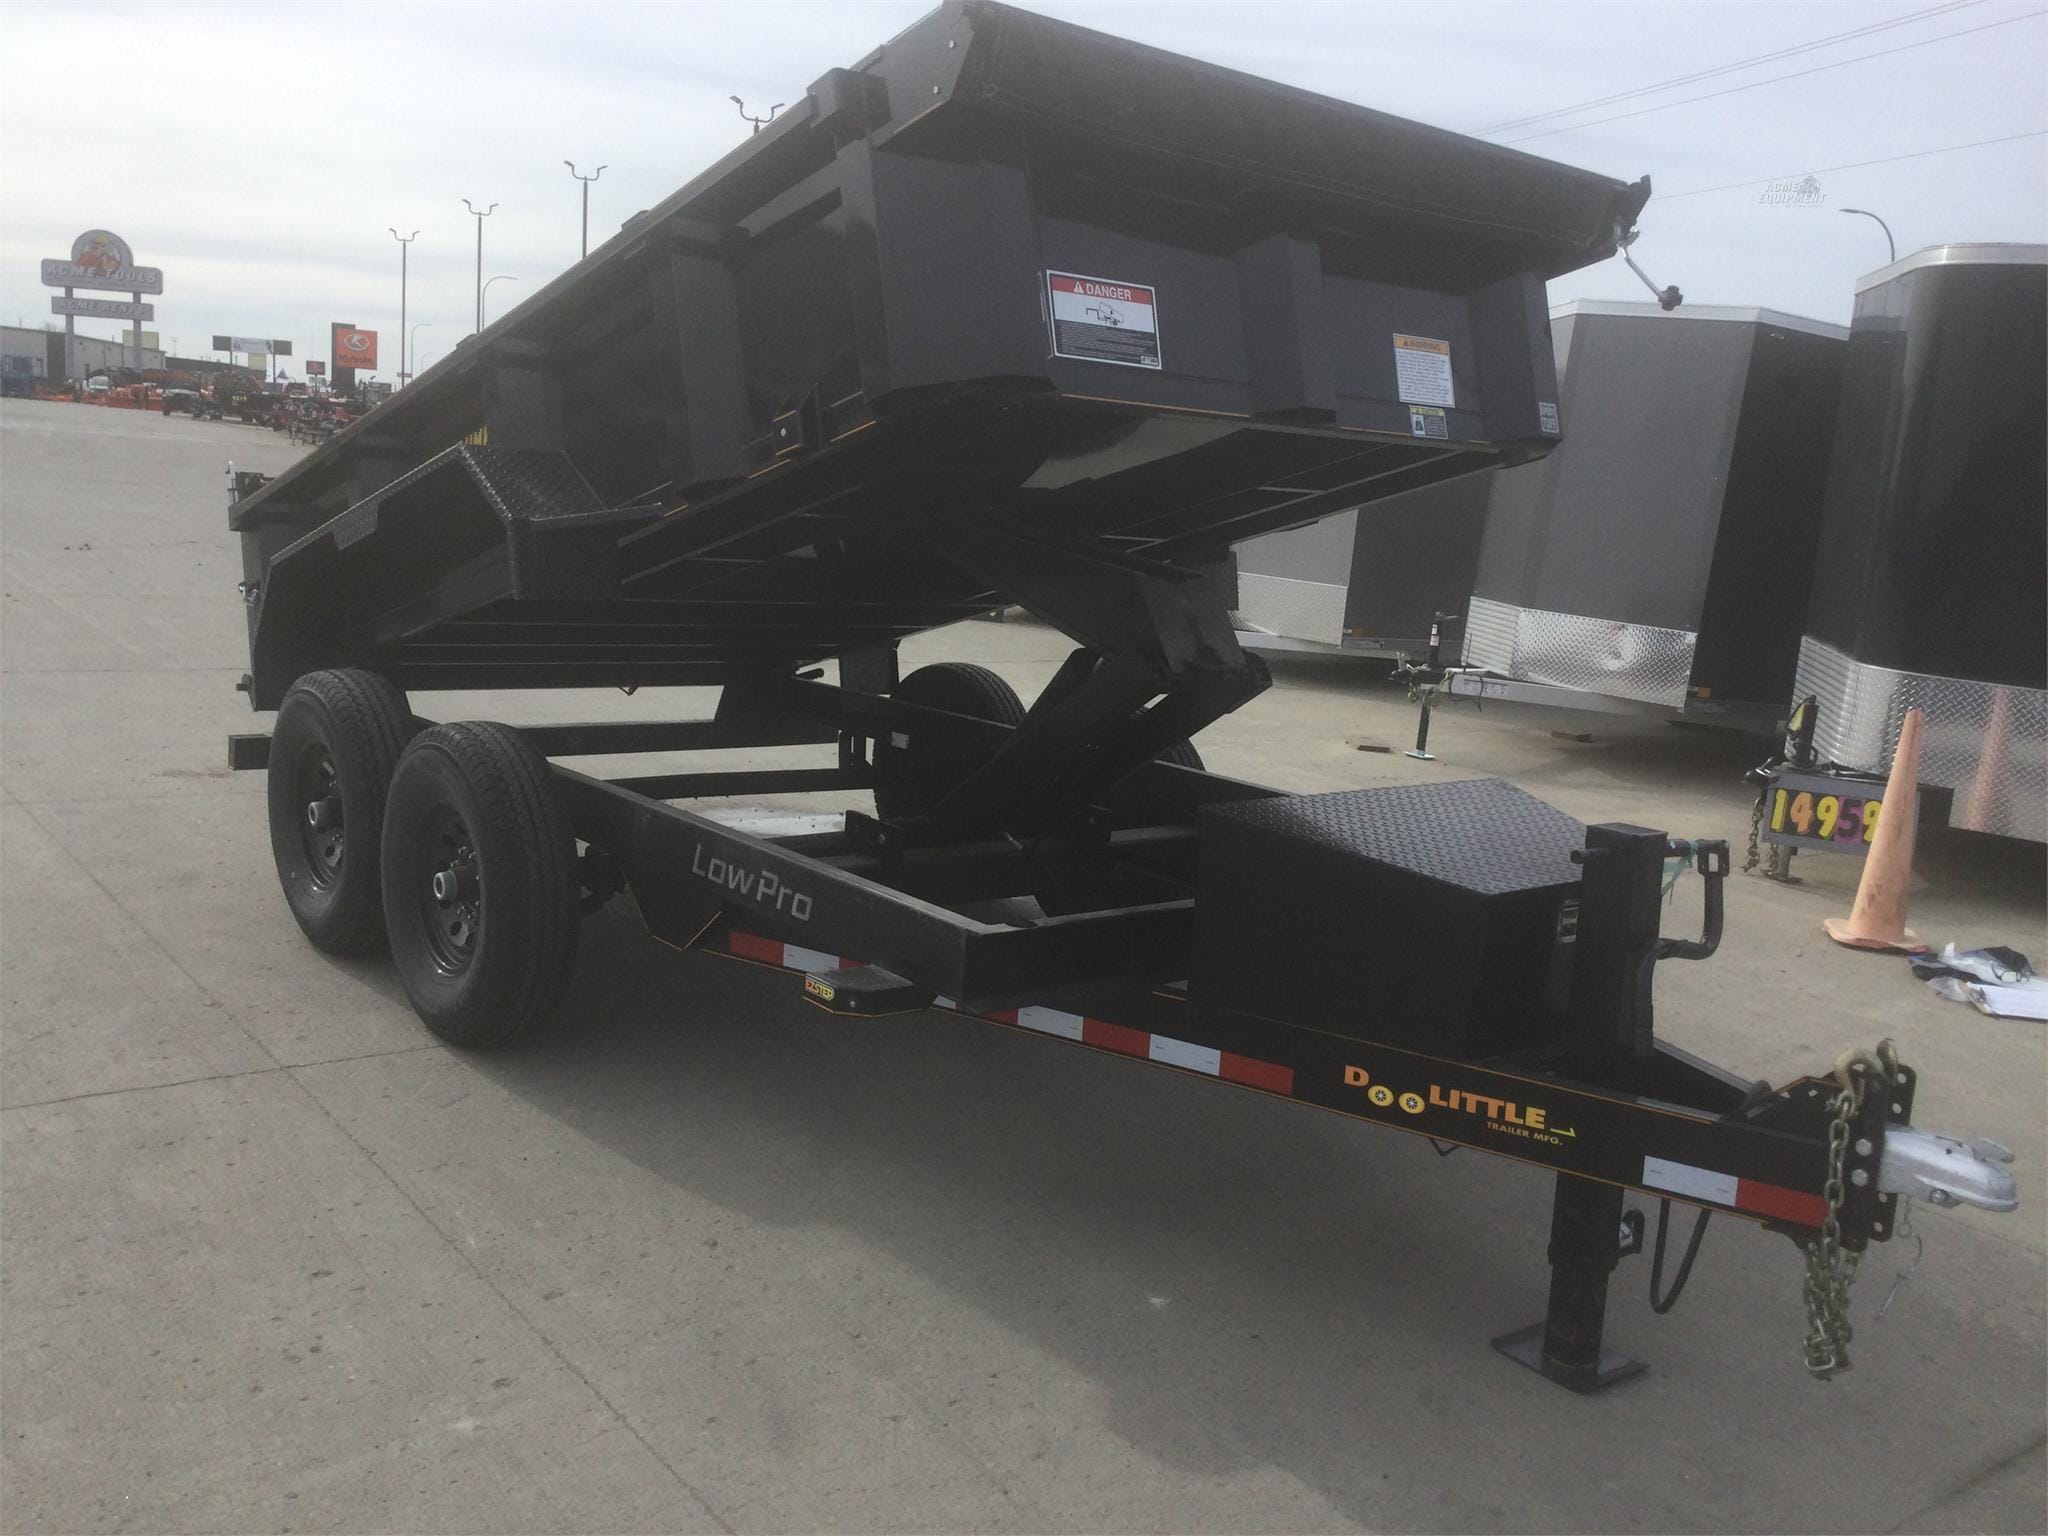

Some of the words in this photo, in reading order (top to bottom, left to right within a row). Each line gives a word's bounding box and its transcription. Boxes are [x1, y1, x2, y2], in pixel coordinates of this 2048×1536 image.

[47, 264, 97, 278] ACME
[105, 269, 156, 283] TOOLS
[1085, 283, 1132, 301] DANGER
[1410, 340, 1442, 351] WARNING
[1770, 788, 1882, 842] 14959
[1486, 1121, 1530, 1139] TRAILER
[1533, 1133, 1564, 1146] MFG.
